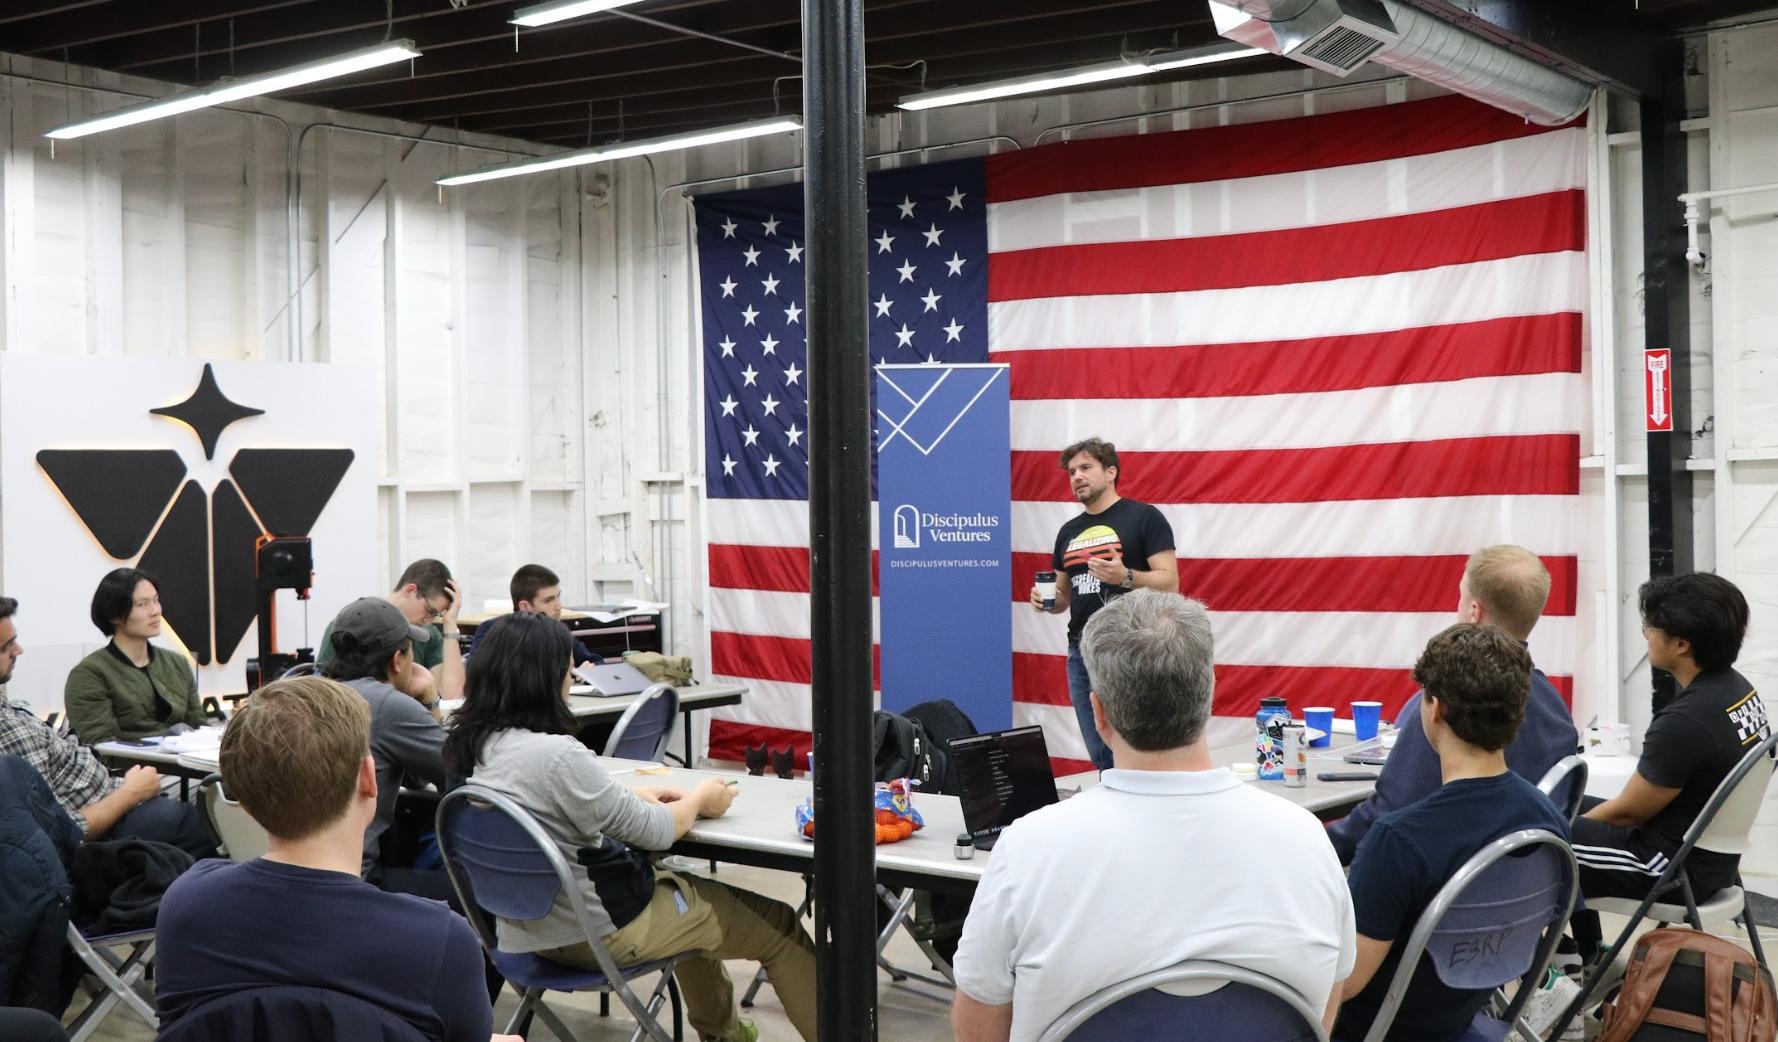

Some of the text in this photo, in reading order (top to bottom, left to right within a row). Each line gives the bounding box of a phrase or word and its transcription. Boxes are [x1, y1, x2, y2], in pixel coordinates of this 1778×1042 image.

[1651, 360, 1664, 369] FIRE
[921, 513, 999, 530] Discipulus
[930, 529, 991, 542] Ventures
[891, 559, 999, 568] DISCIPULUSVENTURES.COM
